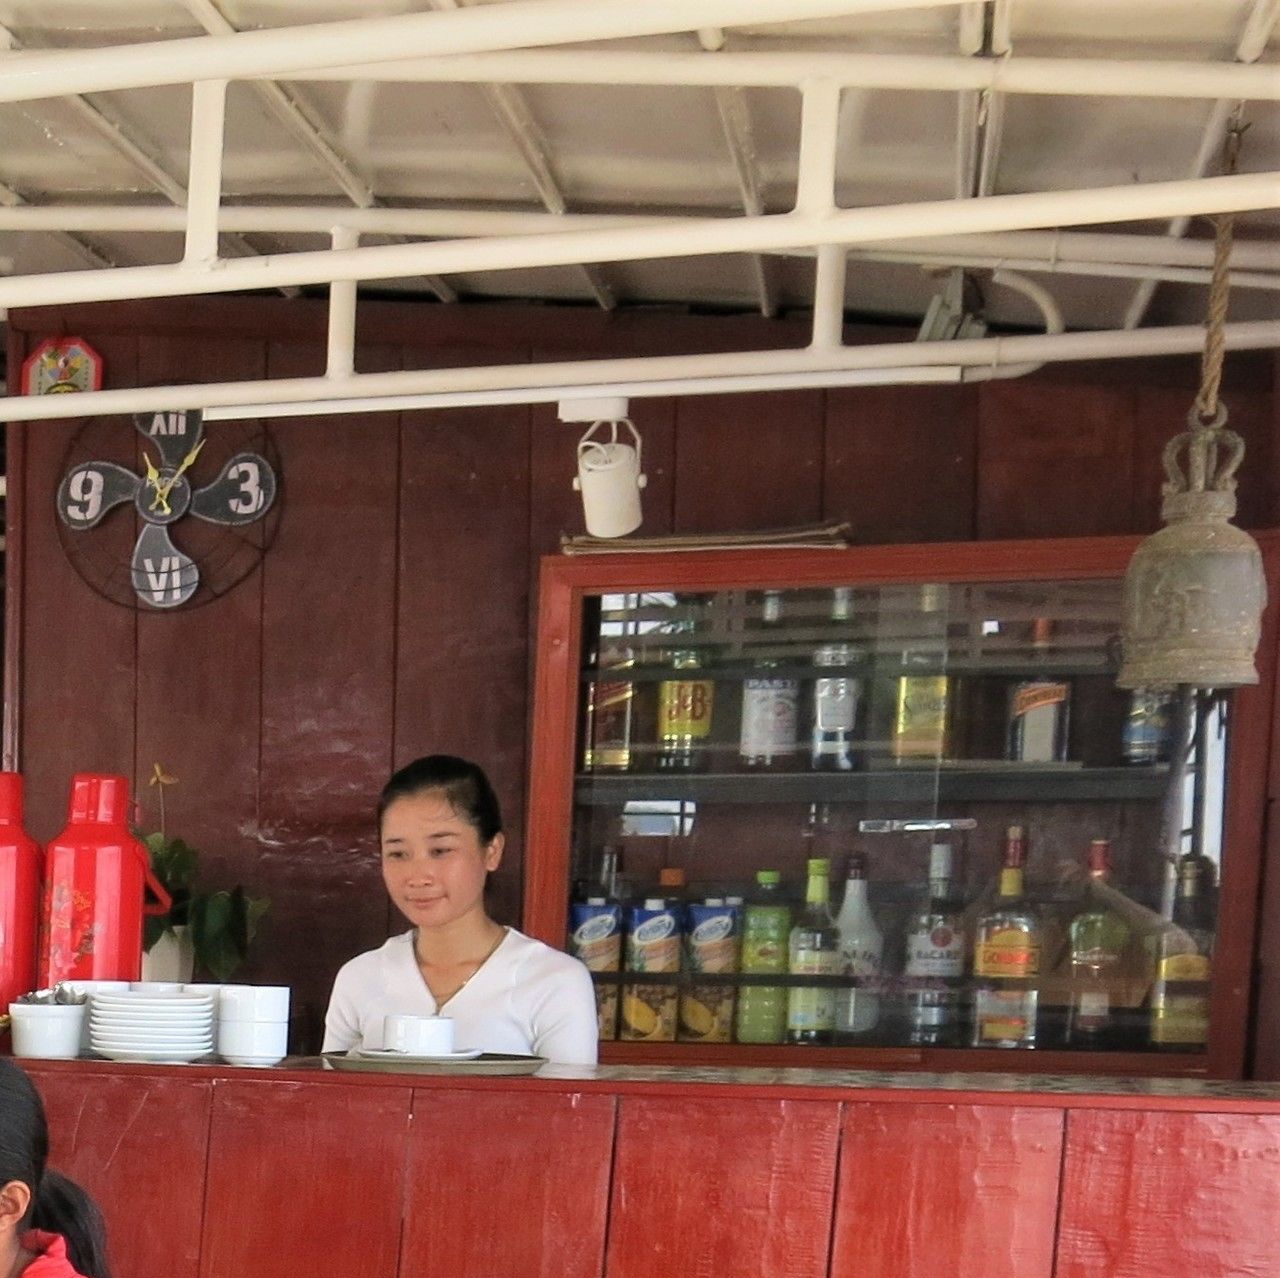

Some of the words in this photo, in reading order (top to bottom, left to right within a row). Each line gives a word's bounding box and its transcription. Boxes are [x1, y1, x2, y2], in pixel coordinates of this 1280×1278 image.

[66, 469, 105, 521] 9
[226, 461, 265, 515] 3
[143, 555, 182, 602] VI
